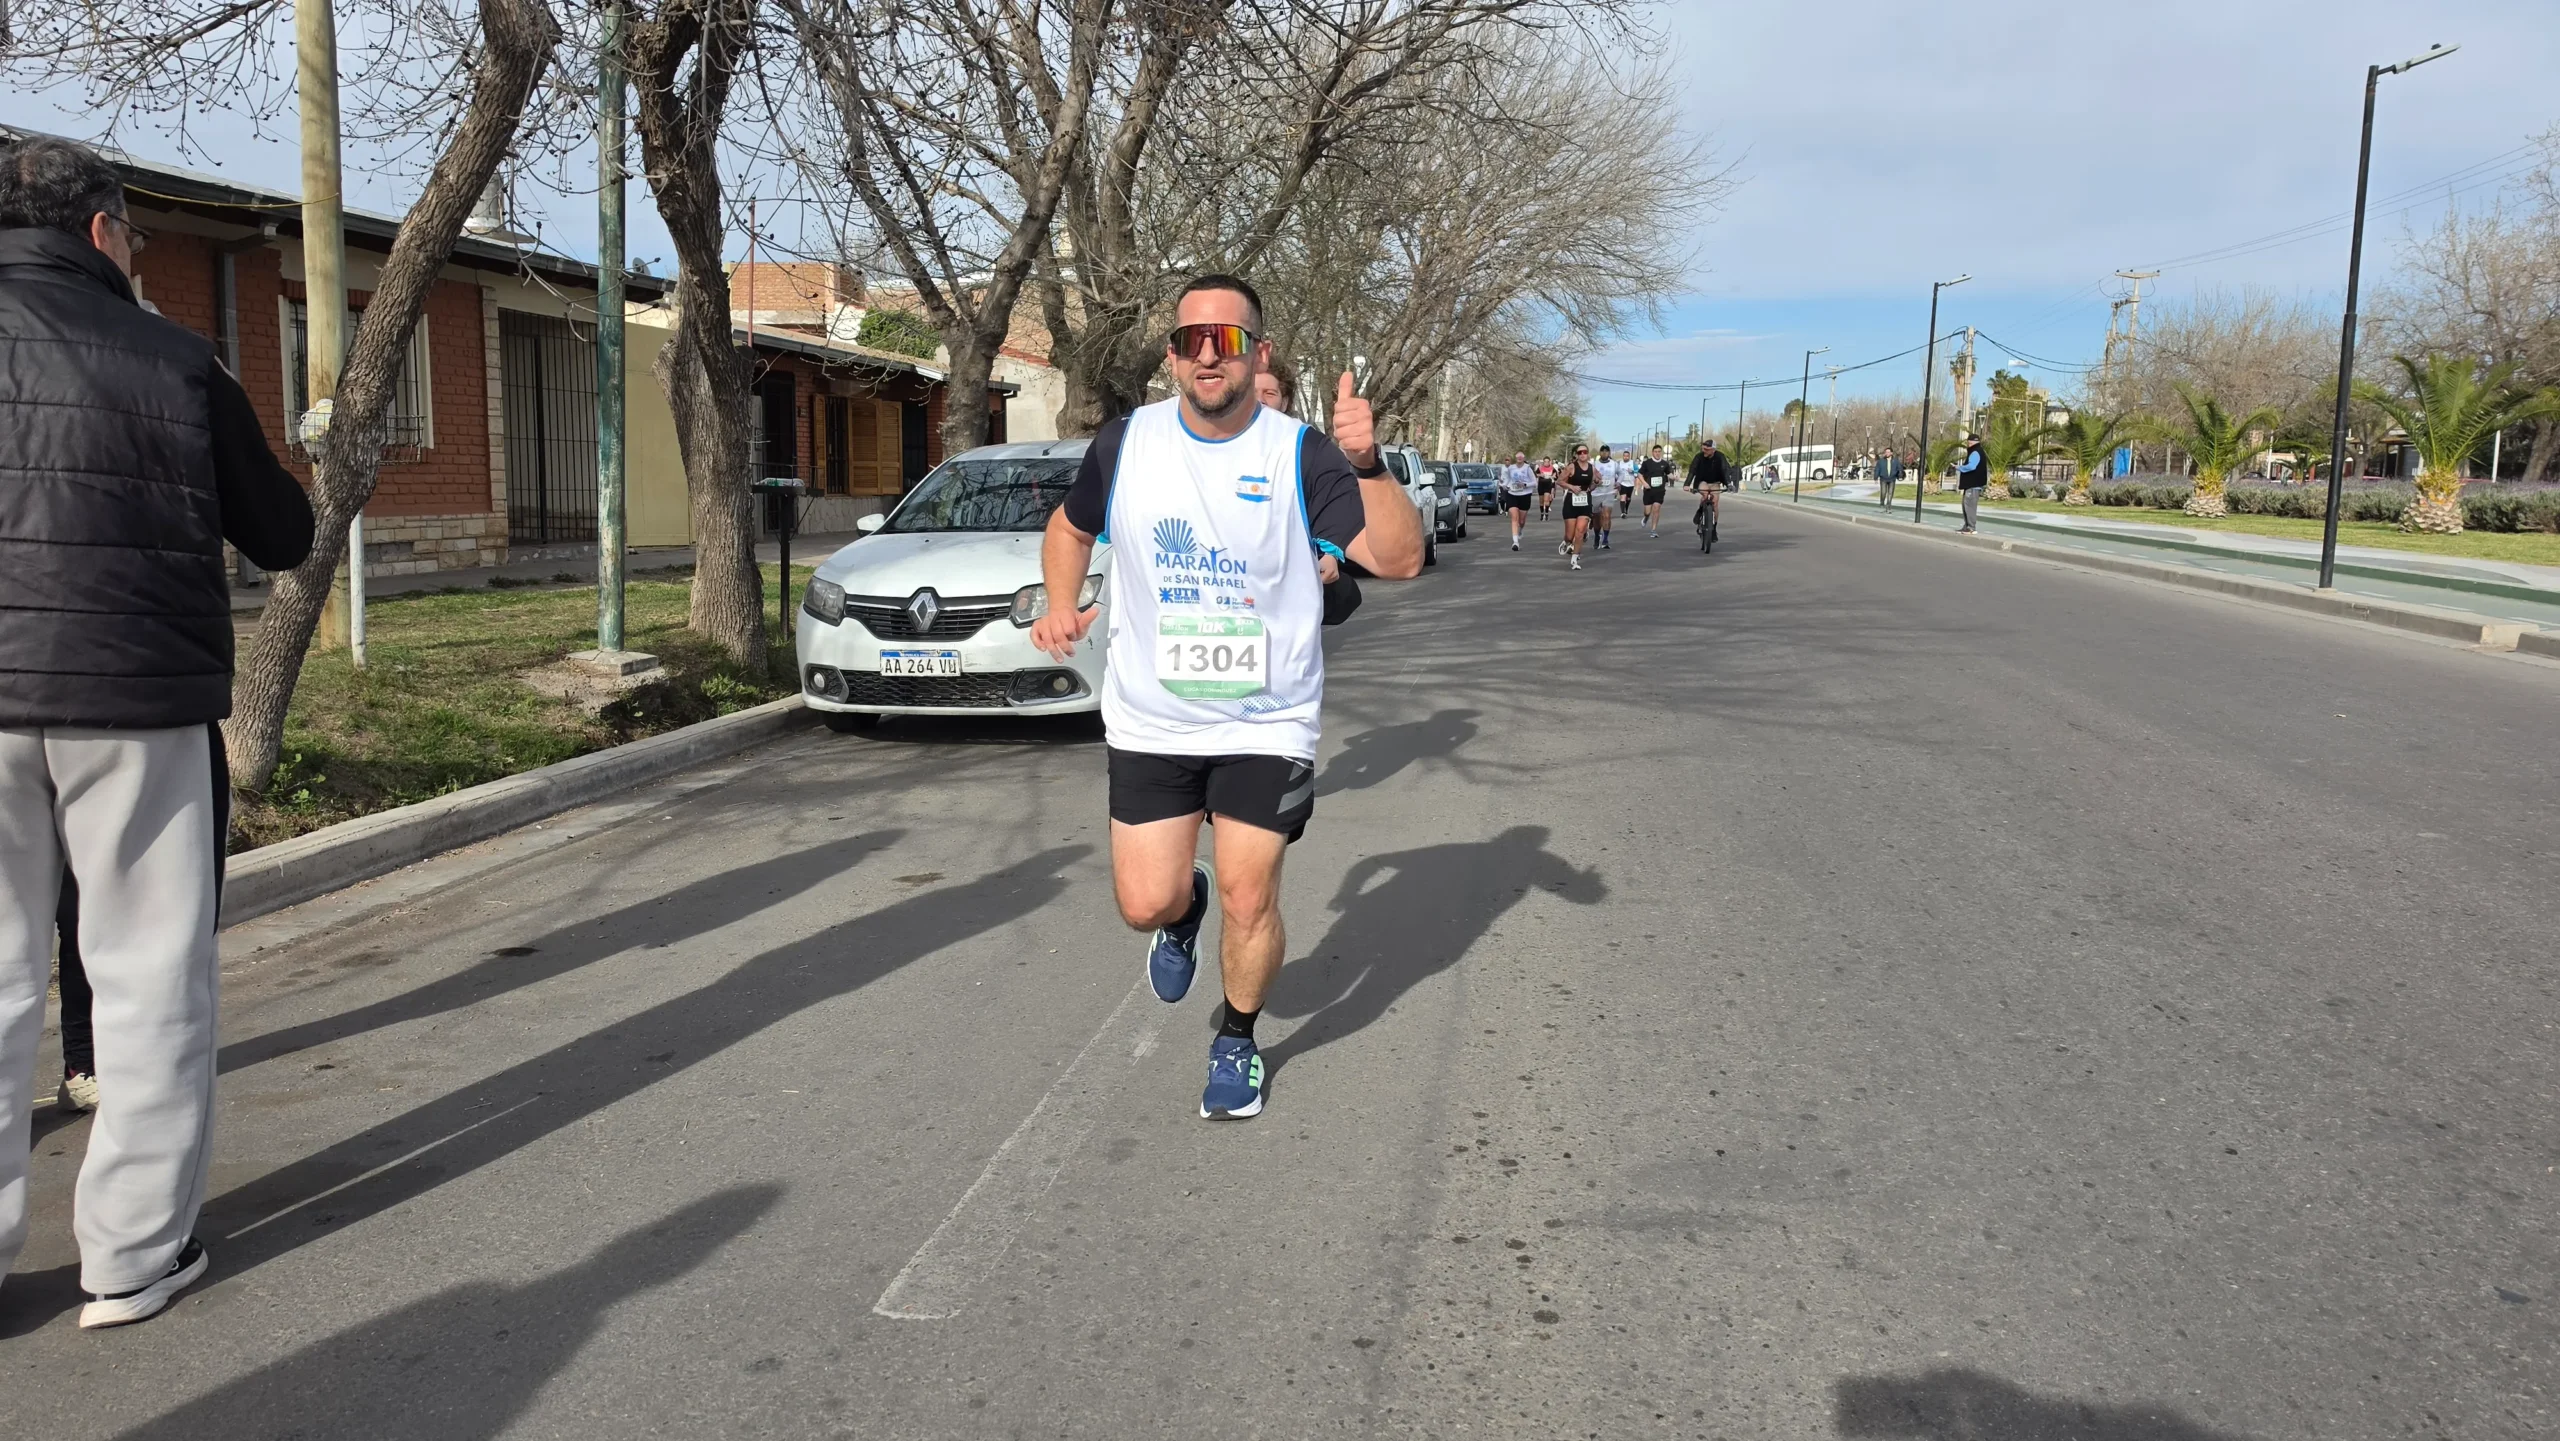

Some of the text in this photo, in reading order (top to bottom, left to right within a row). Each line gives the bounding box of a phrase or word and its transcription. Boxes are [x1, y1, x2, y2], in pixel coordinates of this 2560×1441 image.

[1155, 548, 1247, 576] MARATON
[1163, 574, 1247, 589] DE SAN RAFAEL
[1173, 587, 1201, 597] UTN
[1196, 620, 1226, 634] 10K
[1167, 644, 1259, 672] 1304
[885, 659, 902, 673] AA
[907, 659, 934, 673] 264
